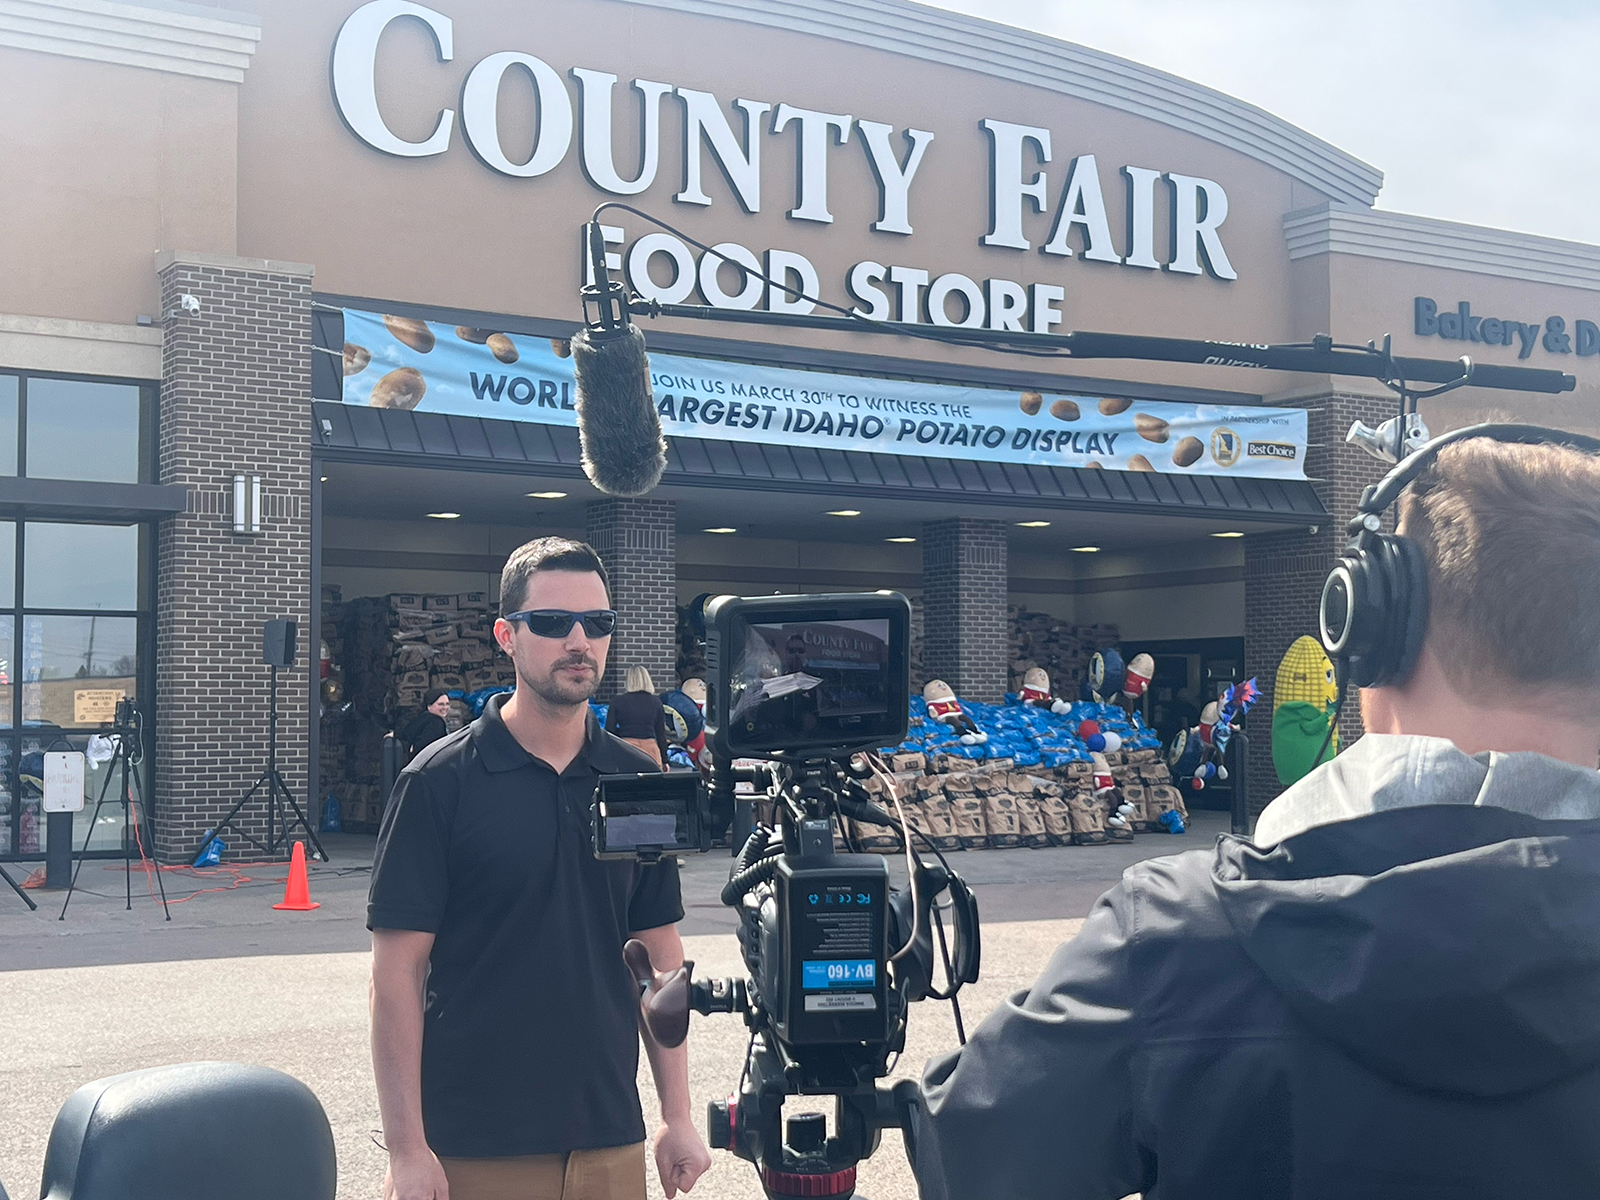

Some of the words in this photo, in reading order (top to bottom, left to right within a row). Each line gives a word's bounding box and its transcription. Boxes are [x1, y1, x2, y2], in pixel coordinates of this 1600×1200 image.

[332, 0, 934, 236] COUNTY
[980, 118, 1237, 280] FAIR
[582, 222, 820, 315] FOOD
[847, 261, 1065, 333] STORE
[1414, 296, 1541, 360] Bakery
[1542, 315, 1573, 354] &
[1575, 319, 1600, 356] D
[469, 371, 576, 411] WORL
[657, 394, 777, 430] ARGEST
[896, 418, 1006, 449] POTATO
[1011, 427, 1119, 455] DISPLAY
[652, 373, 697, 391] JOIN
[701, 379, 726, 394] US
[731, 382, 796, 402] MARCH
[800, 390, 833, 405] 30TH
[837, 394, 860, 408] TO
[864, 397, 938, 416] WITNESS
[941, 403, 972, 418] THE
[1271, 418, 1289, 426] WITH
[1249, 443, 1266, 455] Best
[1266, 444, 1295, 458] Choice
[828, 963, 873, 979] BV-160
